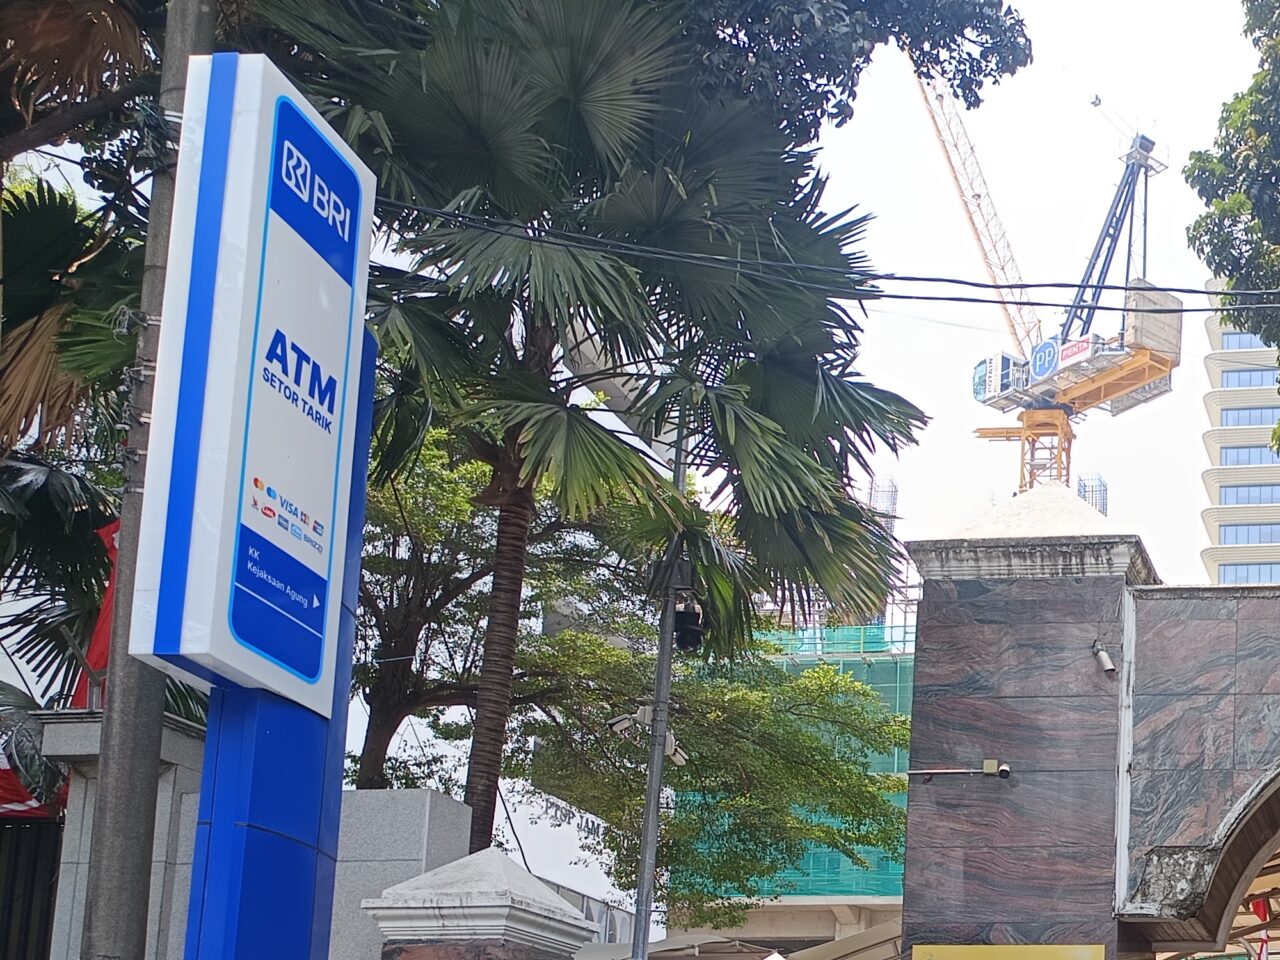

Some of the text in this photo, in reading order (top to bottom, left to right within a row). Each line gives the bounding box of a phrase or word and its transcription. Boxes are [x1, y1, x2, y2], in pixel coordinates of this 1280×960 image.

[312, 174, 350, 242] BRI
[264, 328, 338, 416] ATM
[1035, 348, 1054, 372] PP
[262, 368, 332, 435] SETOR TARIK
[279, 494, 298, 519] VISA
[248, 546, 260, 561] KK
[247, 561, 308, 609] Kejaksaan Agung
